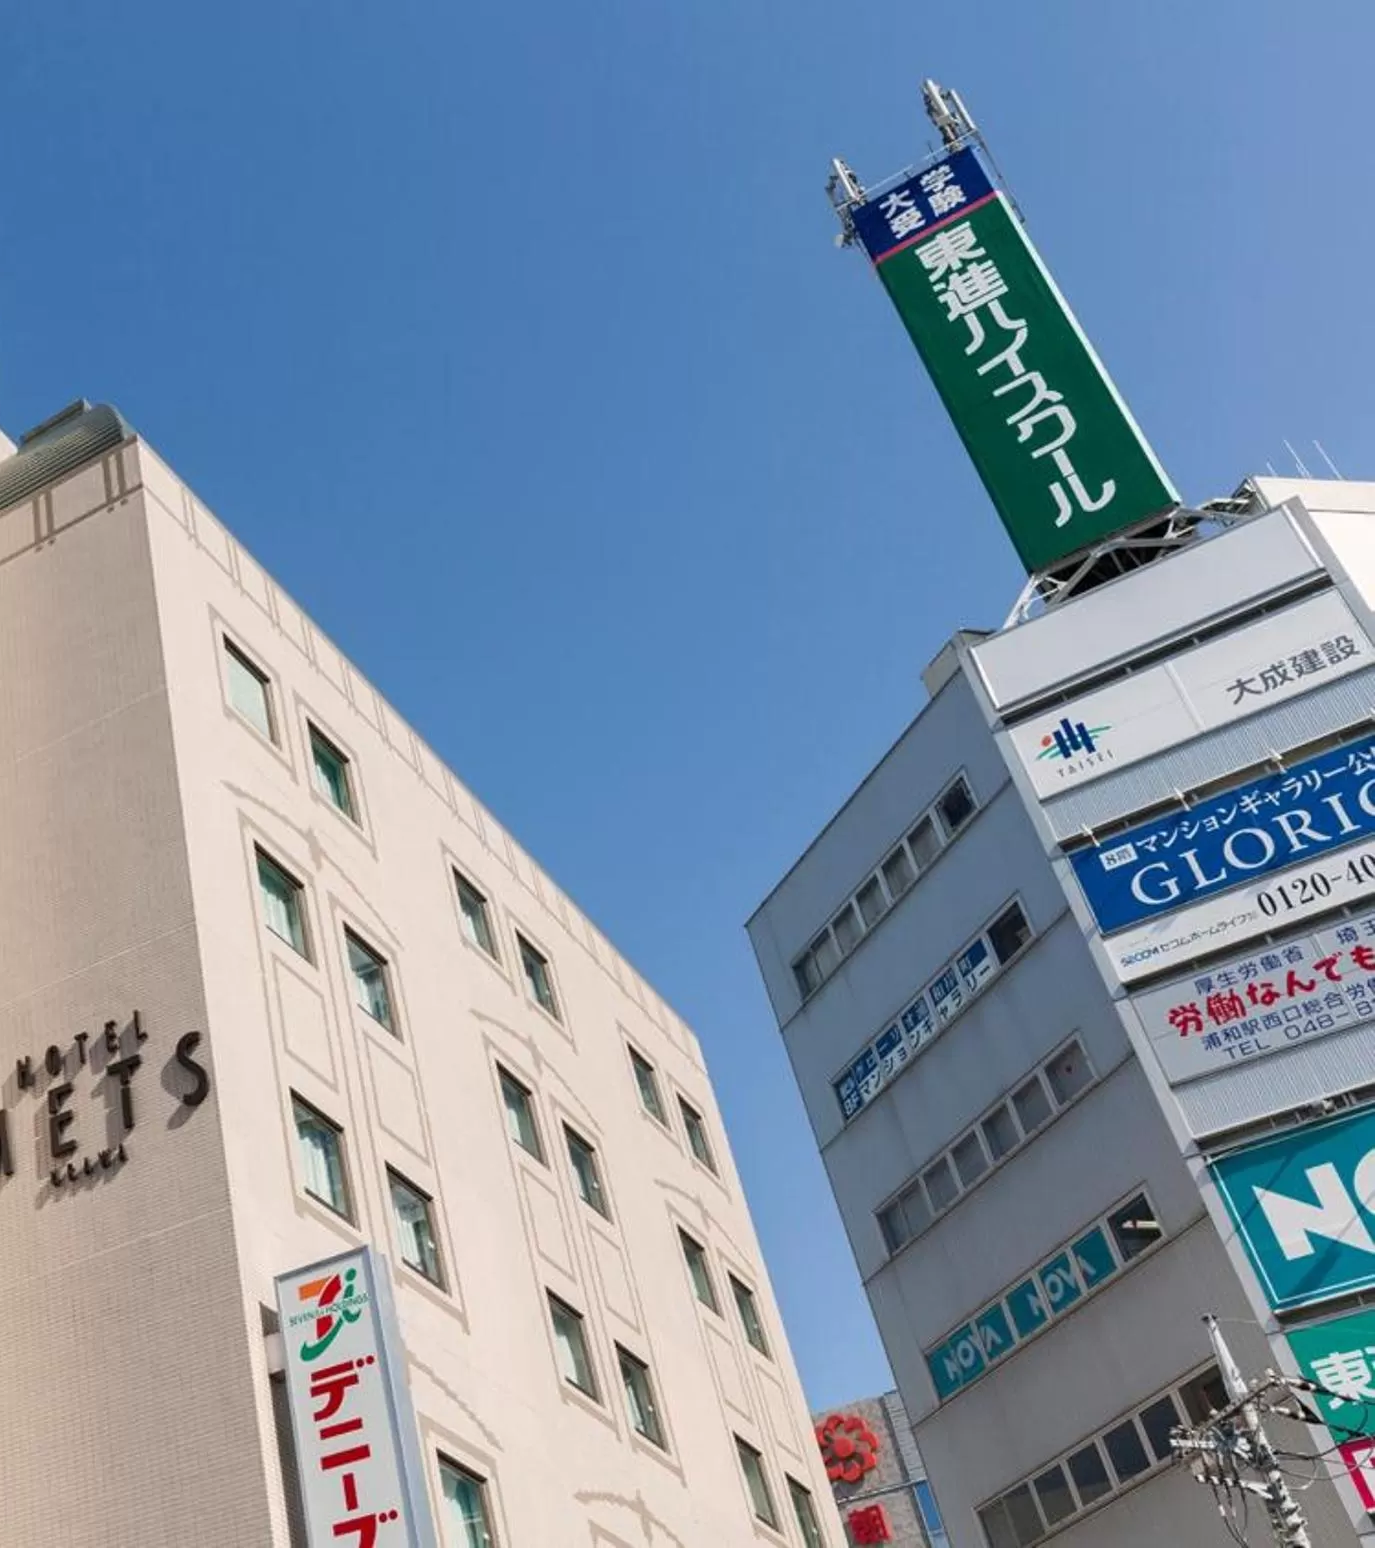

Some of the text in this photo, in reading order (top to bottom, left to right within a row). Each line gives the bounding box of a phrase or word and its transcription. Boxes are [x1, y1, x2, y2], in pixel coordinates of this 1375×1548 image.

[880, 165, 955, 219] 大学
[889, 185, 967, 240] 受験
[914, 221, 1116, 528] 東進ハイスクール
[1226, 635, 1360, 705] 大成建設
[1055, 748, 1114, 779] TAISEI
[1137, 746, 1375, 852] マンションギャラリー公
[1194, 945, 1305, 996] 厚生労働省
[16, 1009, 149, 1091] HOTEL
[1222, 1038, 1272, 1061] TEL
[943, 1323, 1003, 1381] NOVA
